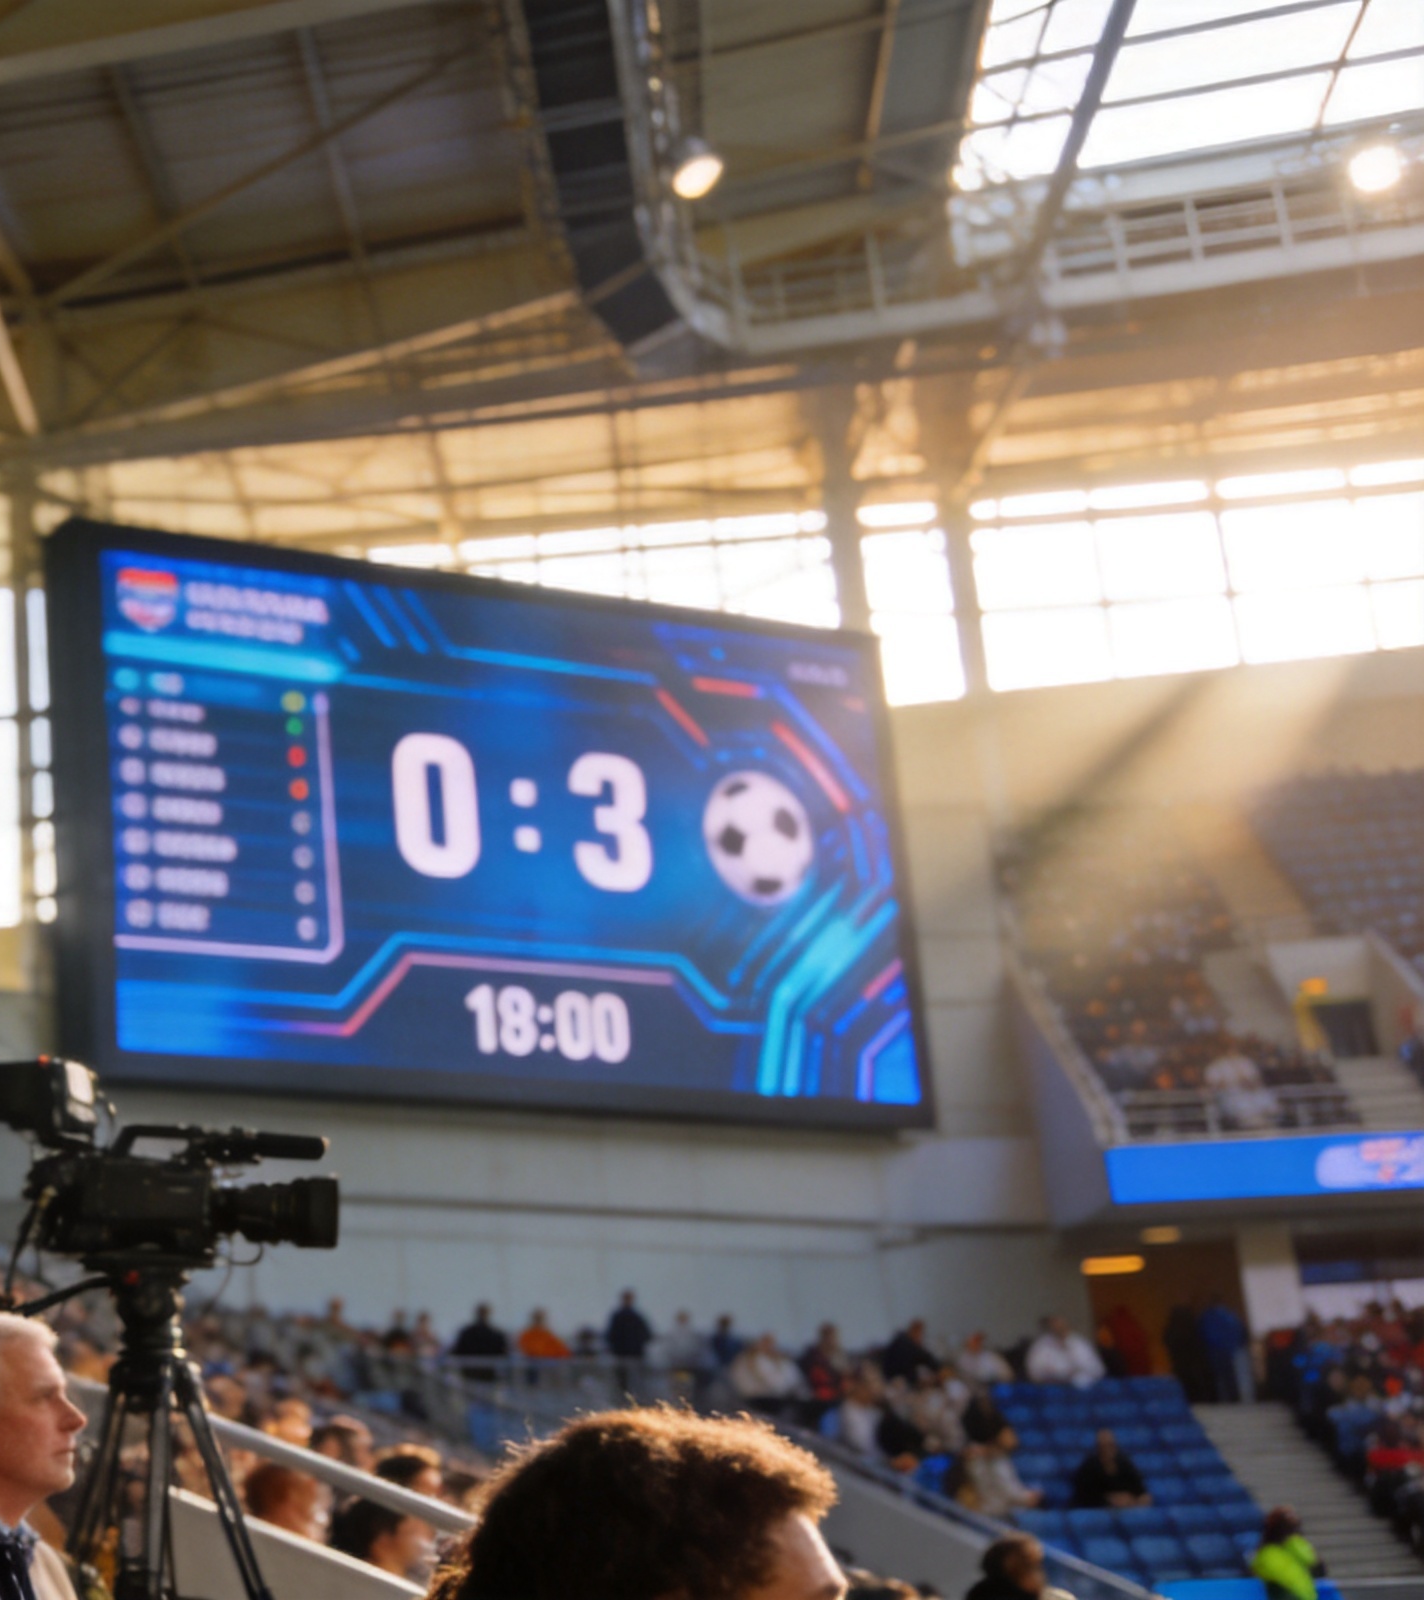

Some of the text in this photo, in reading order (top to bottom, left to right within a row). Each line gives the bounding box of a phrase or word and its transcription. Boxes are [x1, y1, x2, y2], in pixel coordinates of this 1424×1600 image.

[392, 732, 481, 879] 0
[567, 752, 653, 893] 3
[465, 983, 631, 1064] 18:00
